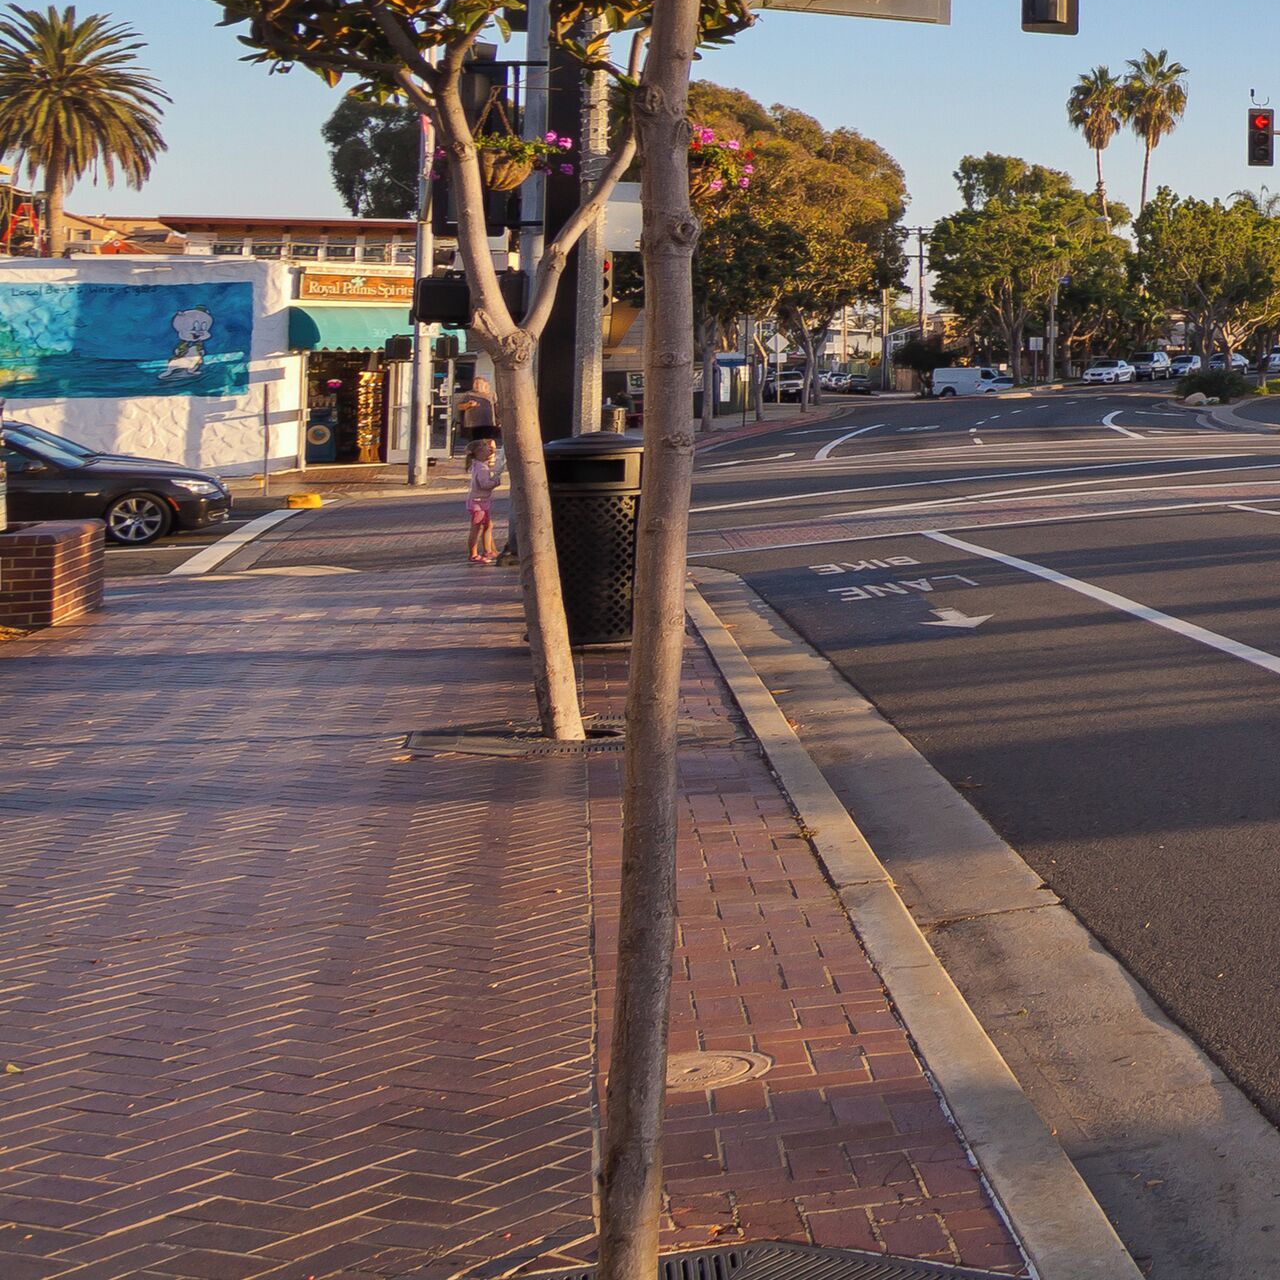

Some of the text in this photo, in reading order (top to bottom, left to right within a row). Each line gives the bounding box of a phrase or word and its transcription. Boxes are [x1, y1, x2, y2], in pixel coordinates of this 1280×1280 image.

[11, 286, 42, 297] Local
[308, 281, 414, 299] Royal Palms Spirits
[808, 556, 922, 575] BIKE
[827, 574, 980, 601] LANE
